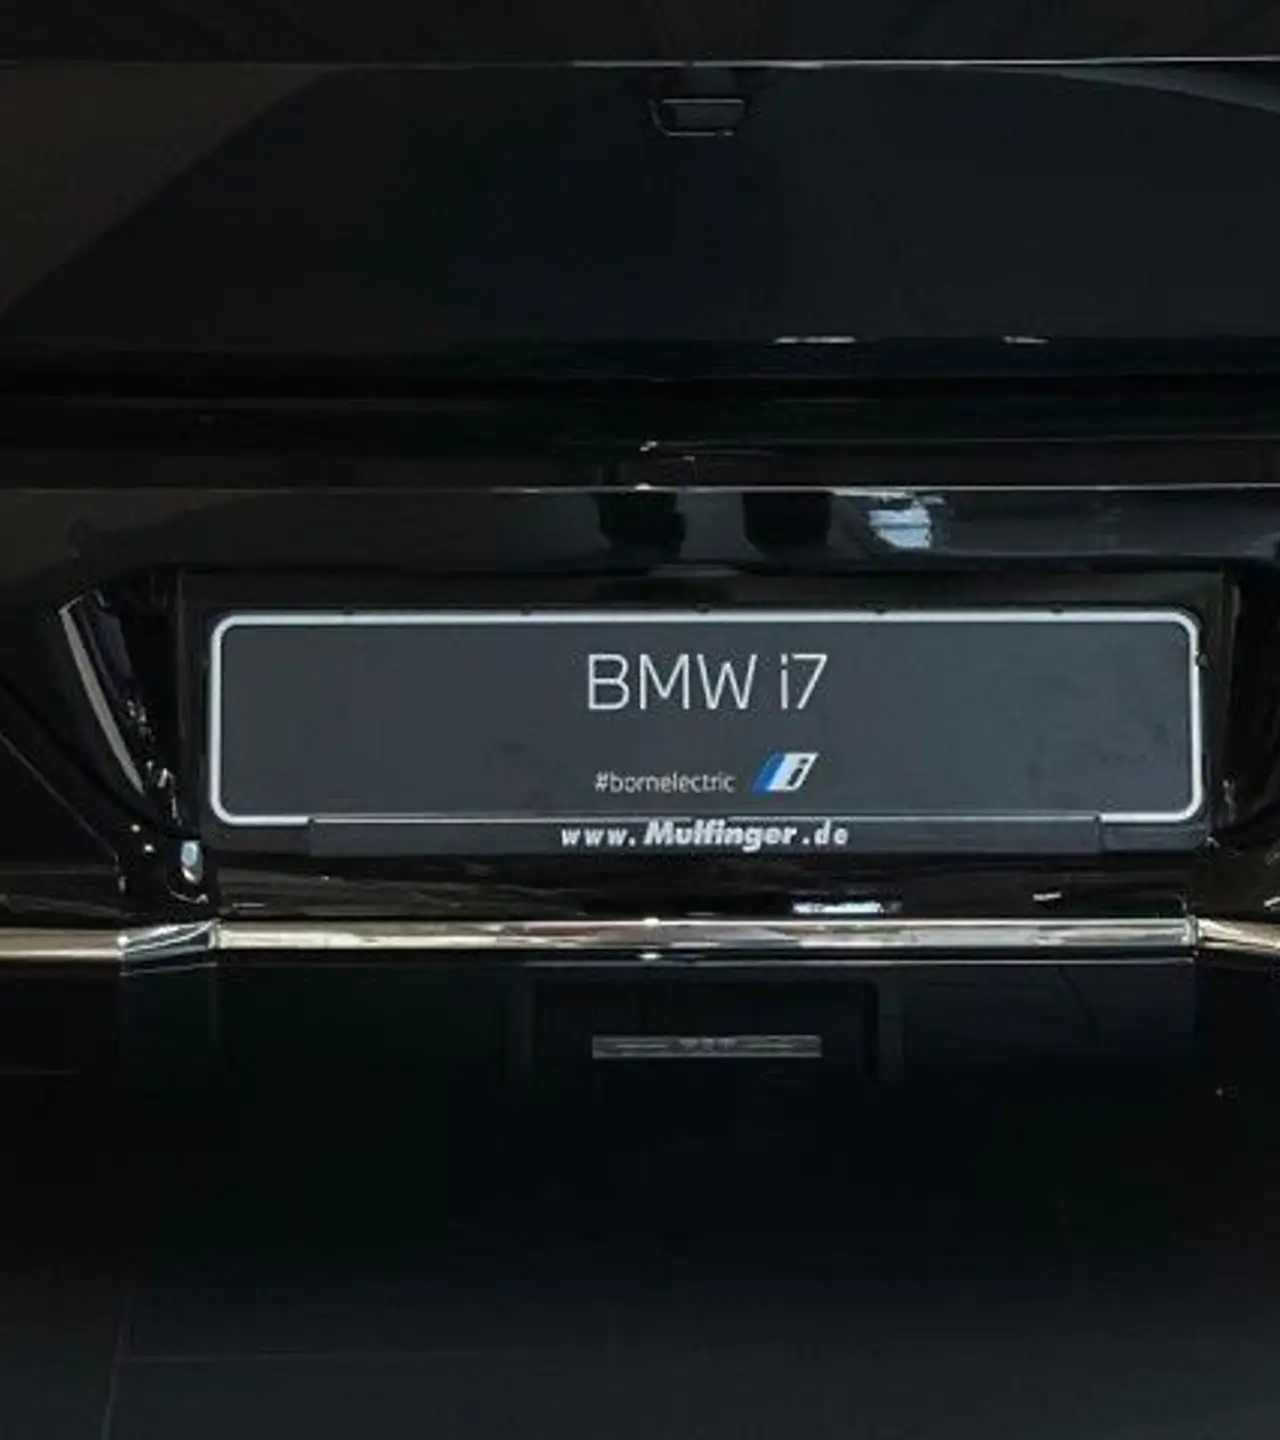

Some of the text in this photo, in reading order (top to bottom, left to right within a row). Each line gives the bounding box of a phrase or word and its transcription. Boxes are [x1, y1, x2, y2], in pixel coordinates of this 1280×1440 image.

[587, 653, 829, 711] BMW i7
[593, 771, 737, 794] #bornelectric
